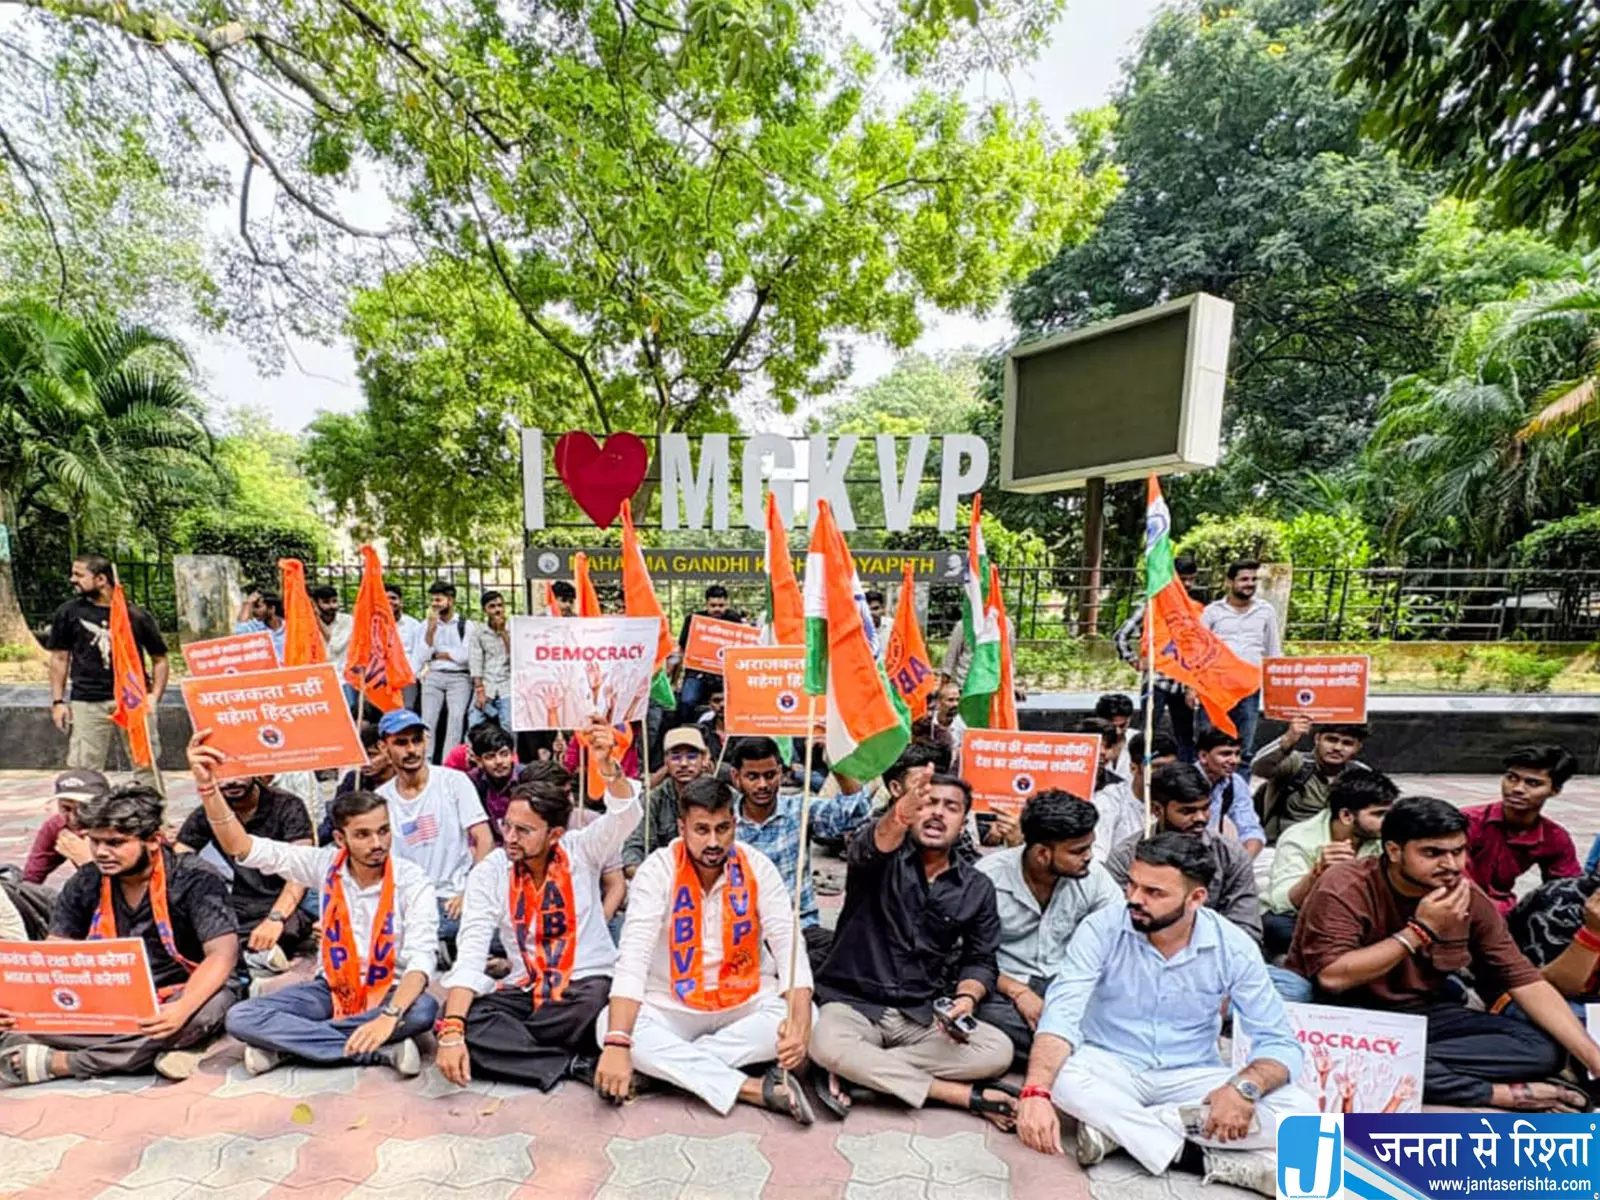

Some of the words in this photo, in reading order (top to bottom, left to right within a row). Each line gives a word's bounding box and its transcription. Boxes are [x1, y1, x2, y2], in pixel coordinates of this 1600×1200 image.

[522, 428, 545, 530] I
[660, 432, 990, 532] MGKVP
[673, 556, 749, 573] GANDHI
[536, 644, 645, 662] DEMOCRACY
[198, 685, 284, 707] अराजकता
[289, 677, 324, 698] नहीं
[216, 708, 258, 726] सहेगा
[261, 701, 330, 723] हिंदुस्तान
[541, 880, 568, 1000] ABVP
[673, 886, 696, 1003] ABVP
